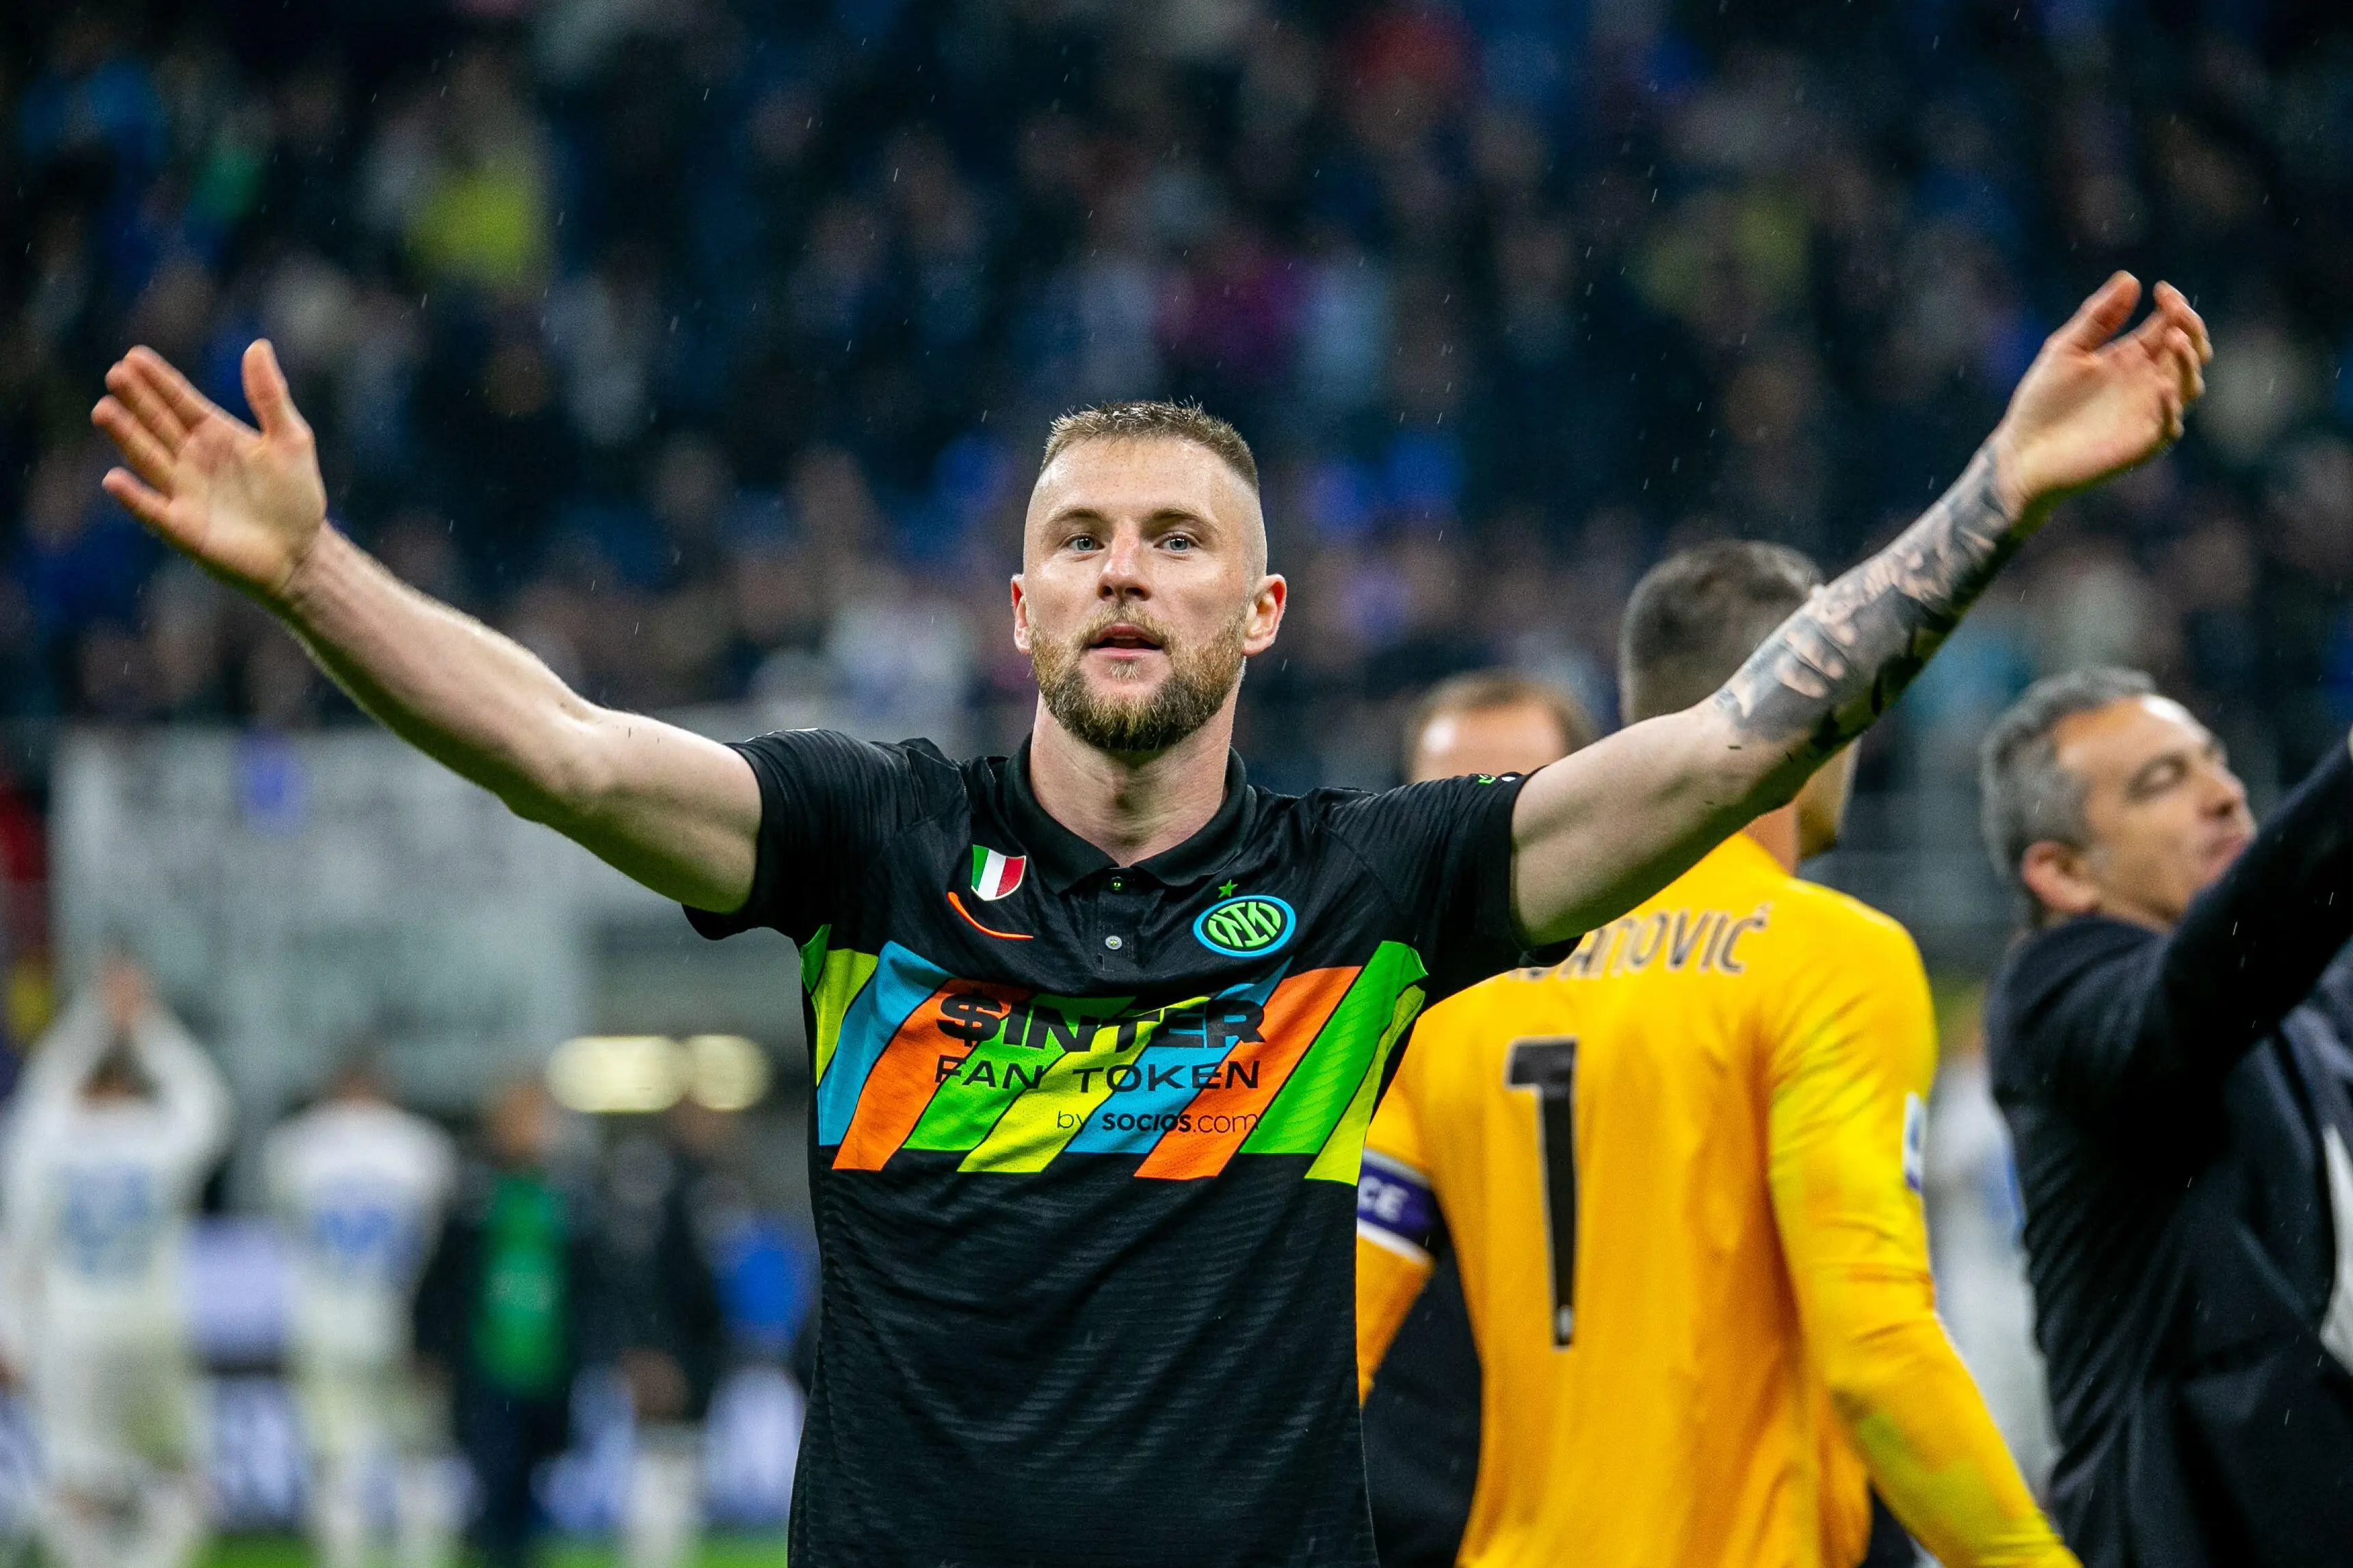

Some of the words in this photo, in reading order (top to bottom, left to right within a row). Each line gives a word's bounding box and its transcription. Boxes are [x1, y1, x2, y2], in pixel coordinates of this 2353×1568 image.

[935, 1055, 1044, 1090] FAN
[1073, 1061, 1260, 1093] TOKEN
[1057, 1111, 1085, 1134] by
[1503, 1035, 1579, 1350] 1
